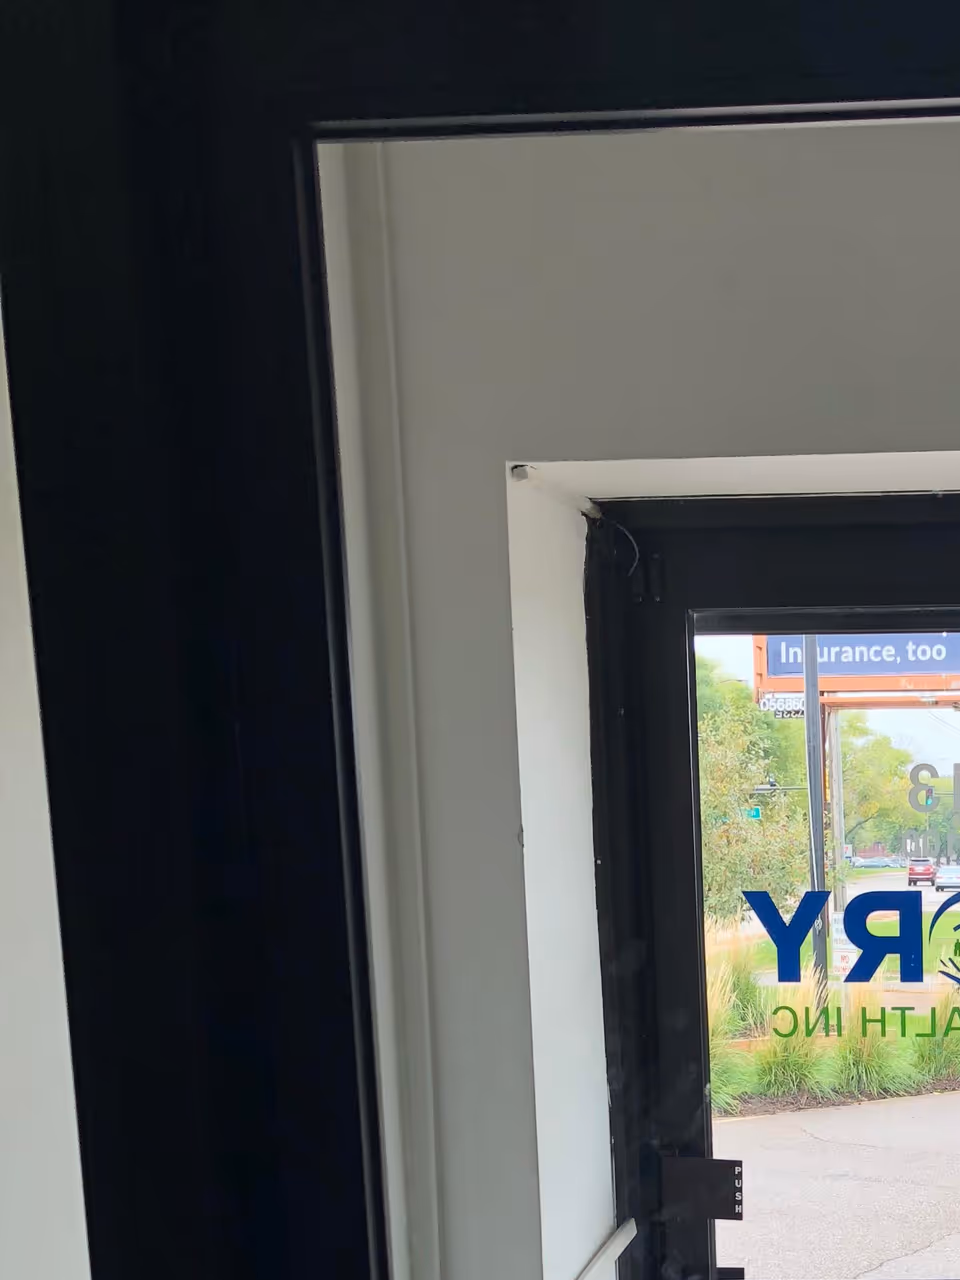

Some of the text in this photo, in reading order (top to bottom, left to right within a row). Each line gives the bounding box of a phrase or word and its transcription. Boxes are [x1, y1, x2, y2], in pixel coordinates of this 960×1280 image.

[781, 640, 947, 664] Inurance, too
[734, 1166, 742, 1213] PUSH
